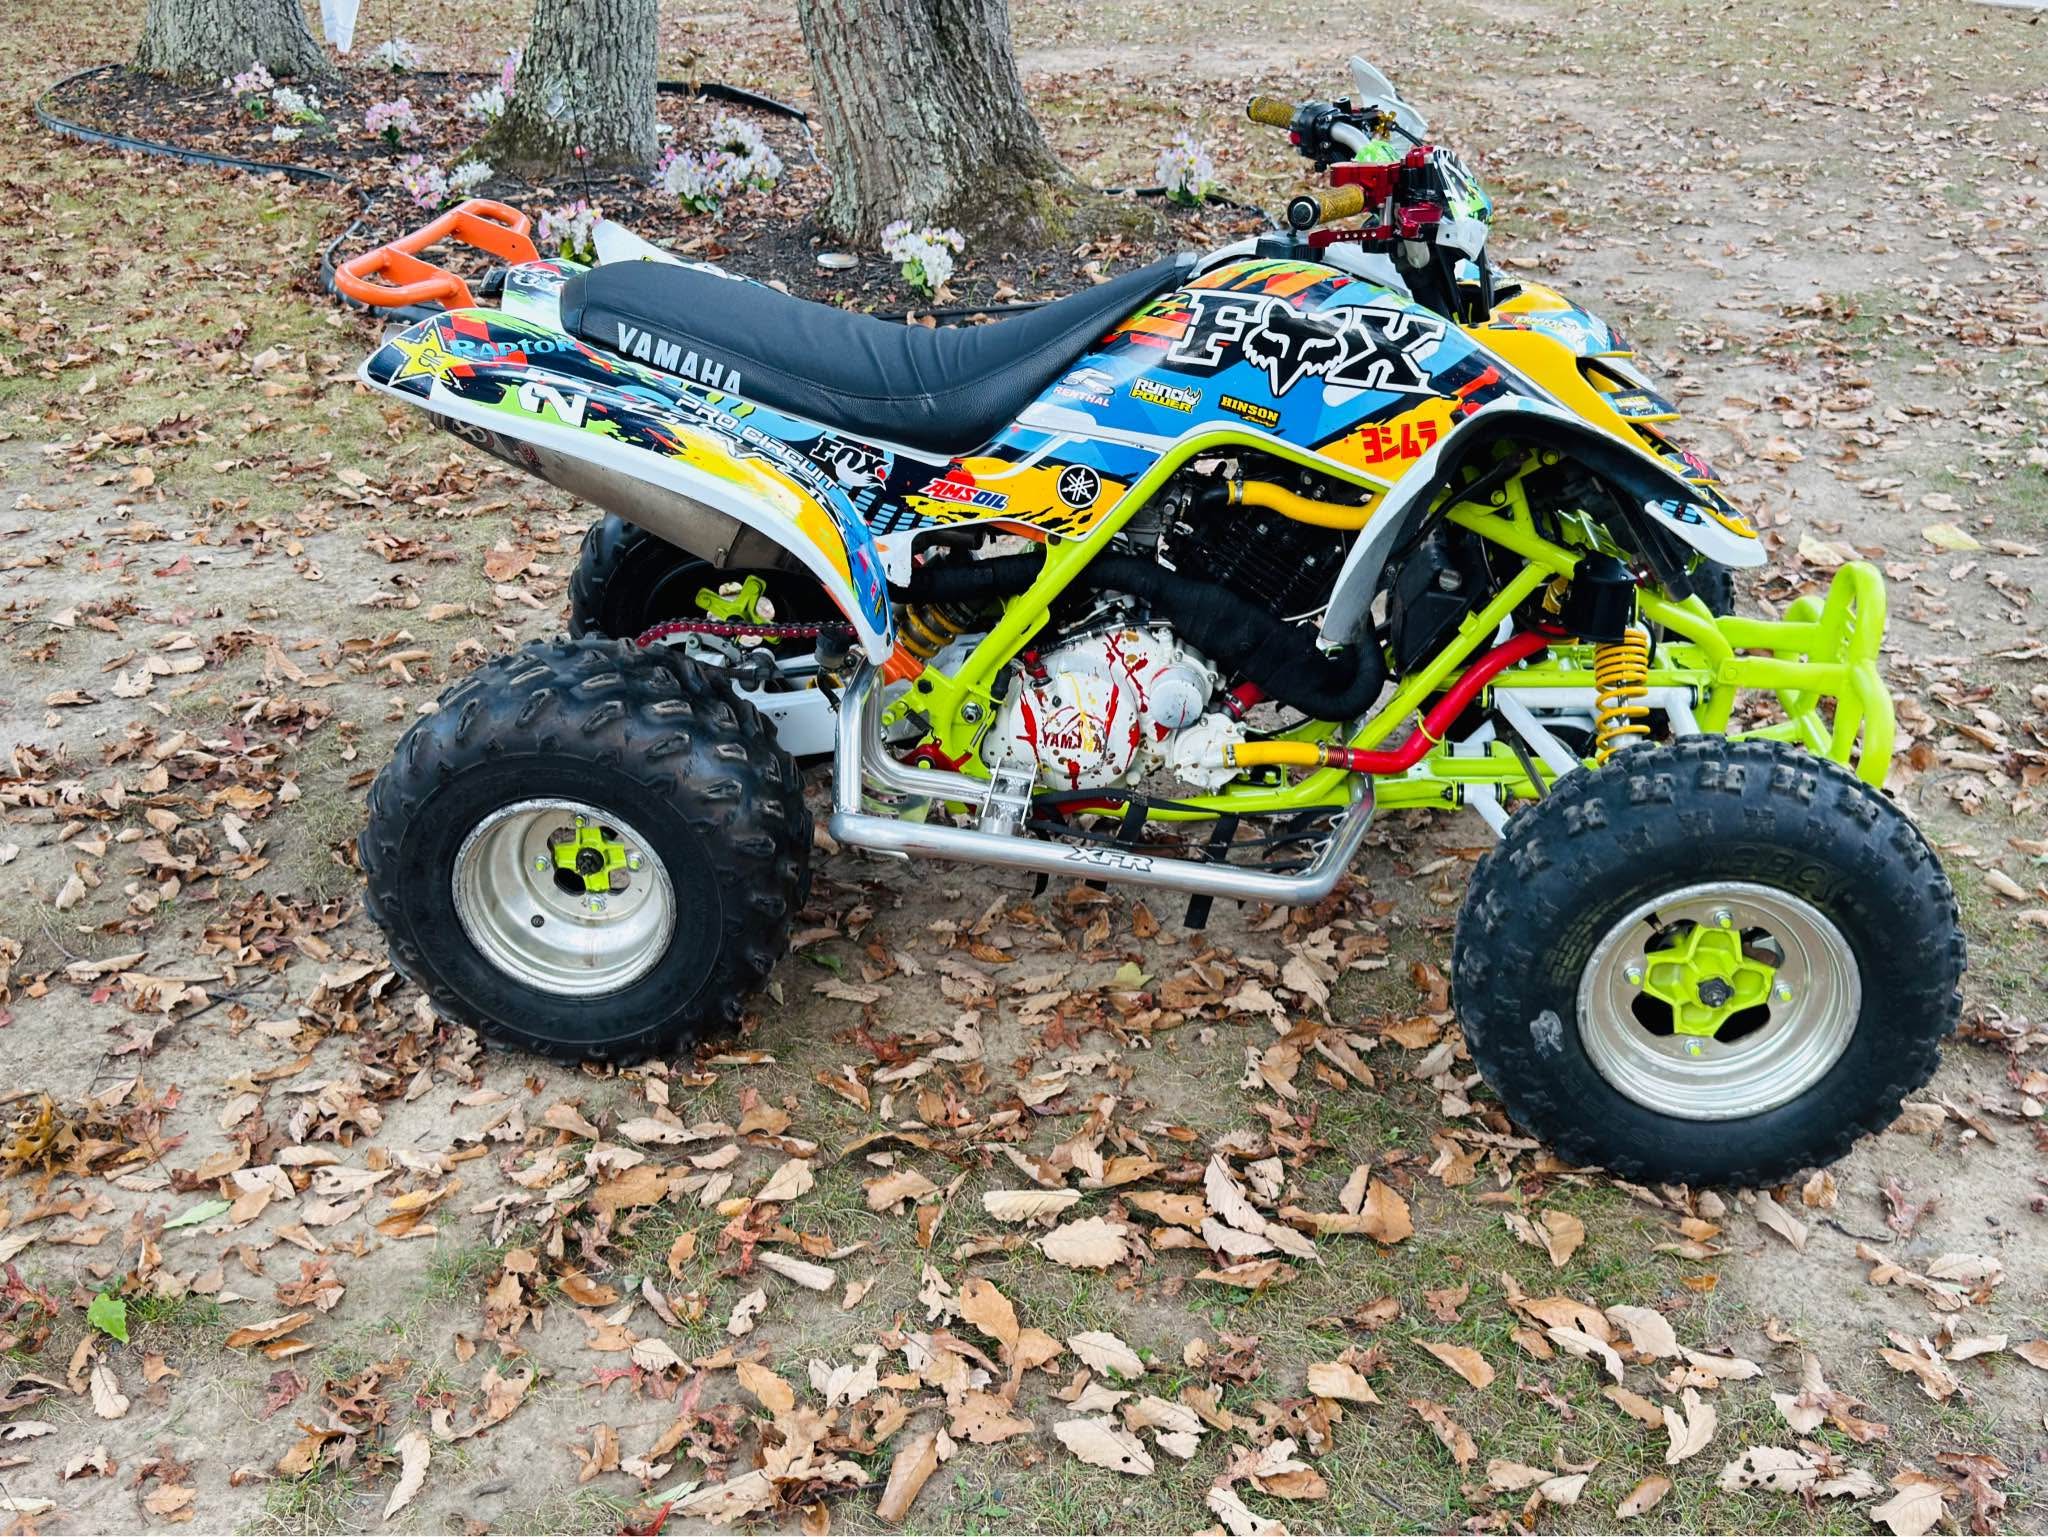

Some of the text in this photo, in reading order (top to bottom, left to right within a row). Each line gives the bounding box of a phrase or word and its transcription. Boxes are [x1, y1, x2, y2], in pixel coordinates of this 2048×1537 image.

[617, 322, 741, 395] YAMAHA
[1053, 386, 1111, 407] RENTHAL
[1131, 388, 1193, 413] POWER
[1133, 377, 1202, 406] RYNO
[1221, 396, 1279, 422] HINSON
[676, 396, 739, 430] PRO
[741, 425, 840, 491] CIRCUIT
[809, 435, 892, 477] FOX
[1361, 420, 1437, 464] ヨシムラ
[920, 478, 1010, 510] AMSOIL
[1064, 846, 1153, 872] XFR
